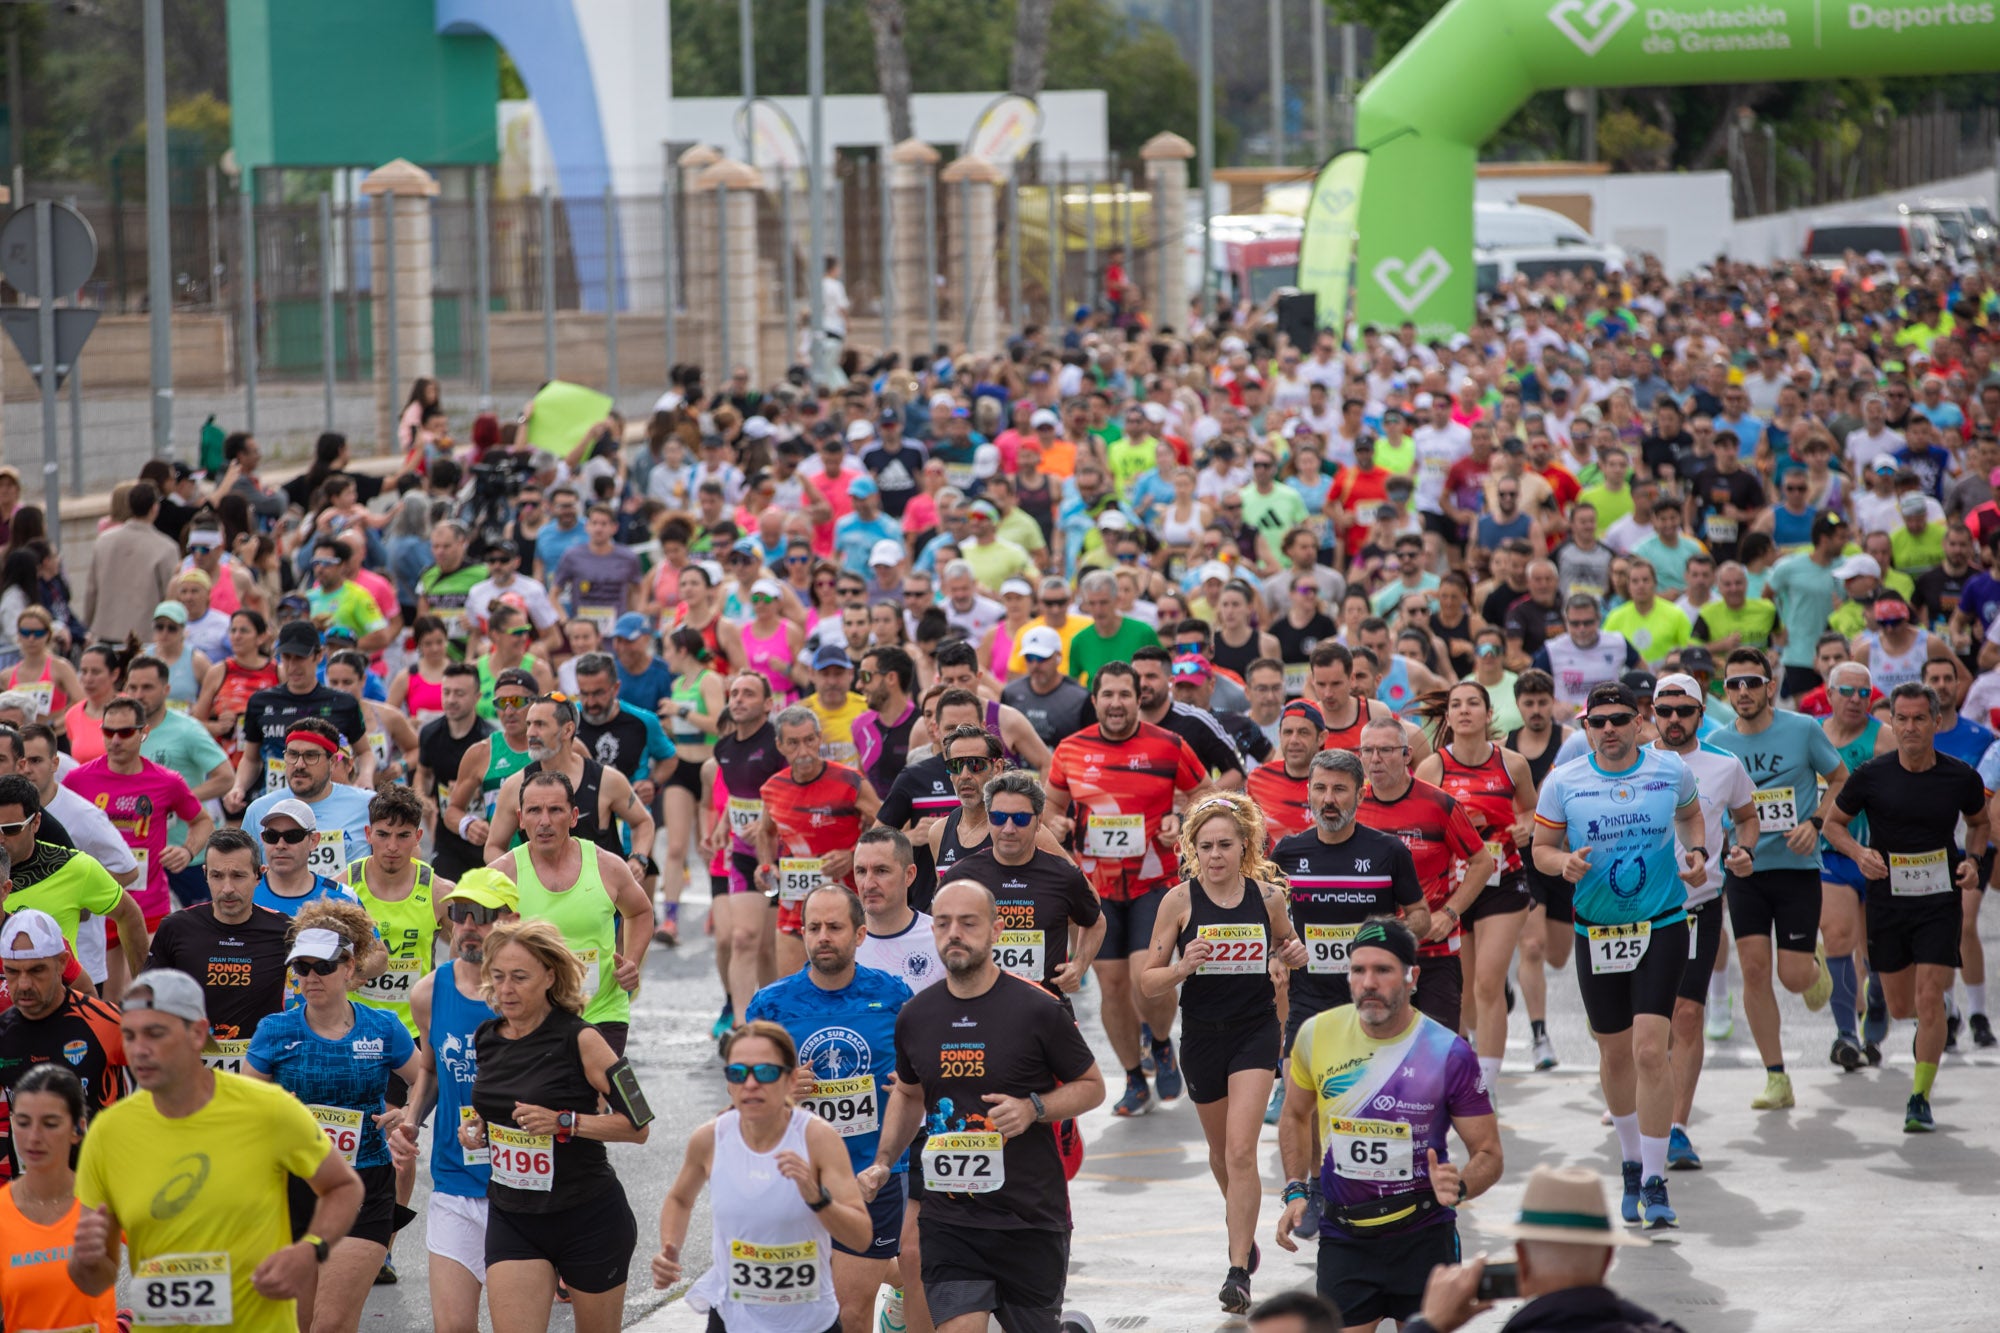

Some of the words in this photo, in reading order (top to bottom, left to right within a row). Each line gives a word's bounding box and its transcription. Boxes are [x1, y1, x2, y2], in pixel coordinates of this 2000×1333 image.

[1646, 5, 1787, 31] Diputación
[1848, 2, 1996, 32] Deportes
[1642, 33, 1676, 54] de
[1680, 30, 1790, 52] Granada
[1744, 753, 1784, 773] IKE
[1757, 803, 1794, 820] 133
[1605, 813, 1651, 828] PINTURAS
[1102, 831, 1129, 846] 72
[1587, 830, 1624, 842] Miguel
[1641, 827, 1668, 837] Mesa
[787, 874, 822, 889] 585
[996, 906, 1034, 915] FONDO
[1207, 928, 1218, 937] 38
[1600, 940, 1642, 960] 125
[207, 963, 252, 973] FONDO
[206, 973, 252, 986] 2025
[801, 1034, 826, 1059] SIERRA
[827, 1030, 846, 1038] SUR
[846, 1032, 867, 1053] RACE
[940, 1050, 985, 1061] FONDO
[940, 1061, 985, 1078] 2025
[819, 1084, 859, 1094] FONDO
[1340, 1121, 1352, 1131] 38
[491, 1144, 551, 1175] 2196
[1350, 1140, 1388, 1165] 65
[934, 1154, 991, 1177] 672
[742, 1245, 755, 1257] 38
[732, 1263, 816, 1289] 3329
[147, 1280, 216, 1308] 852
